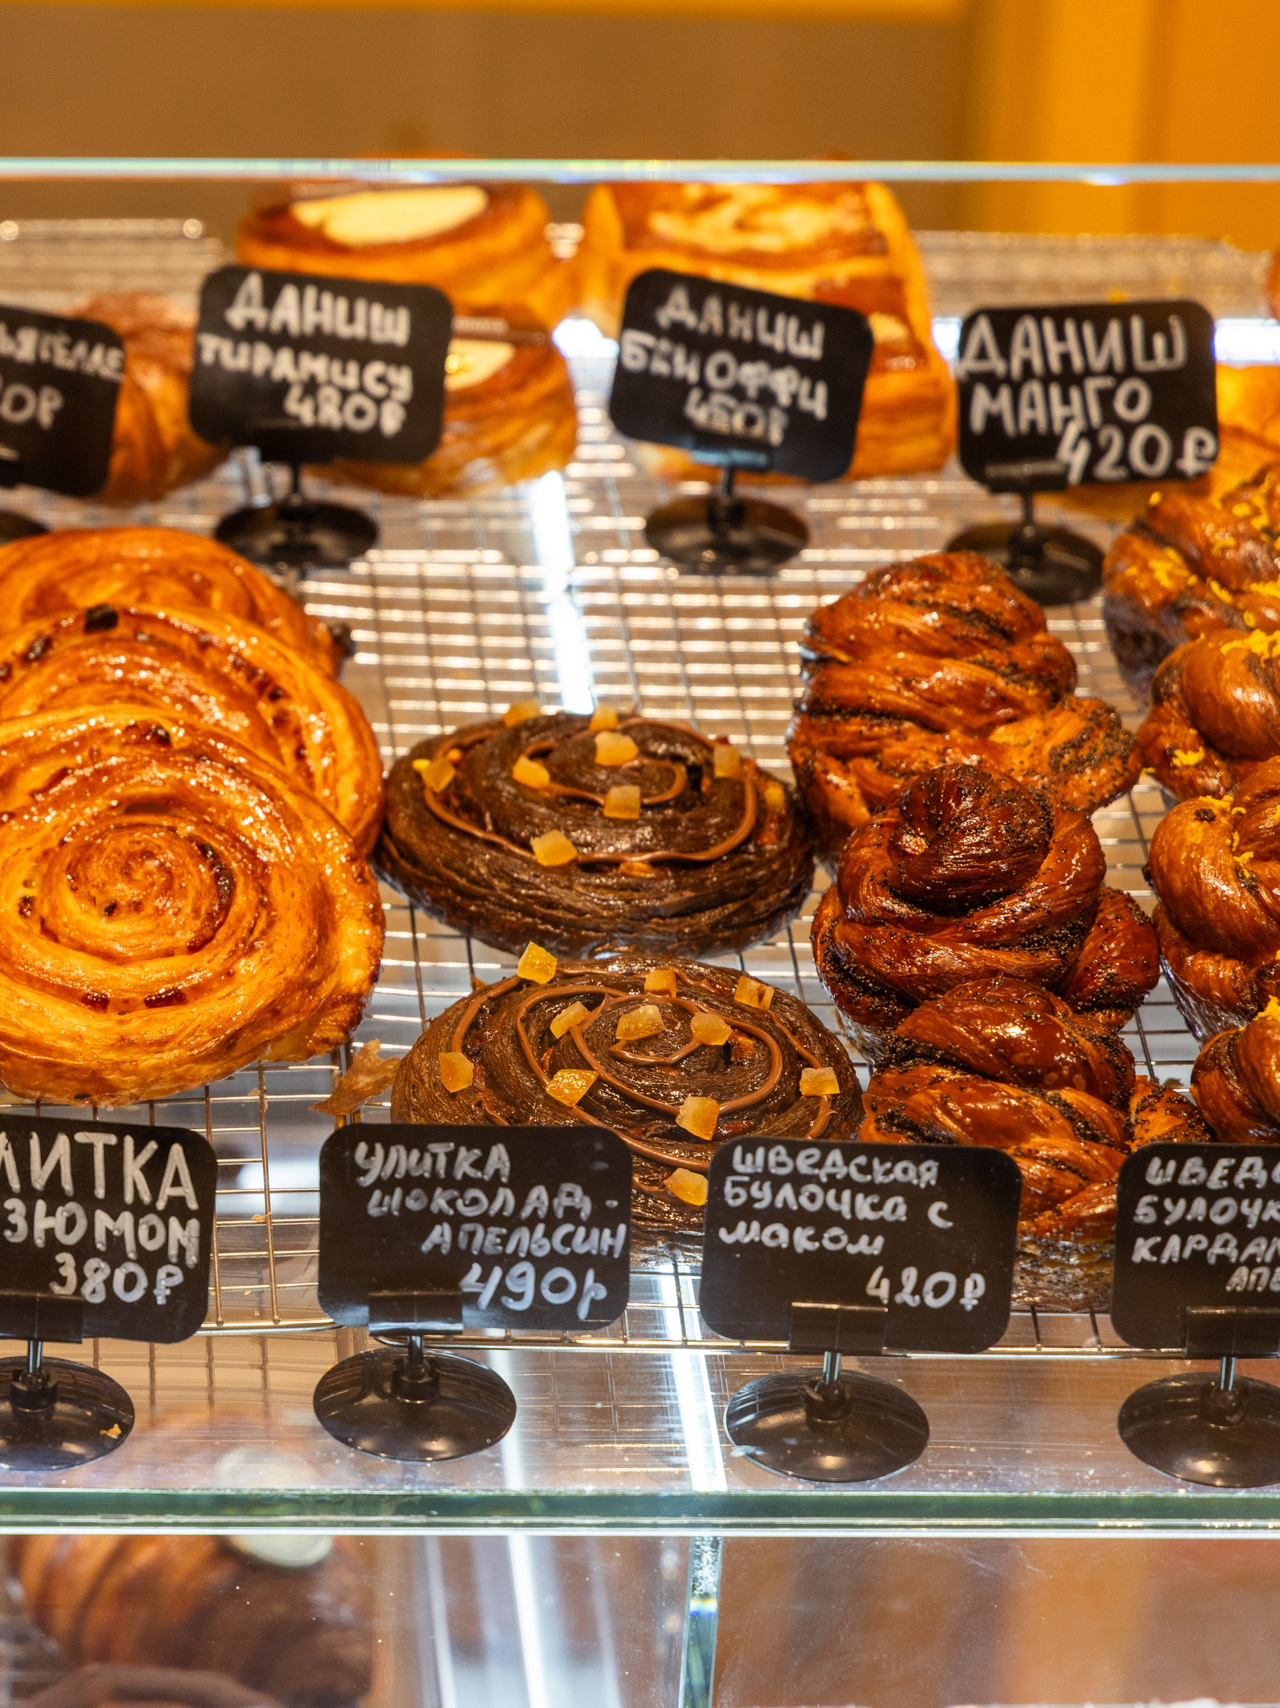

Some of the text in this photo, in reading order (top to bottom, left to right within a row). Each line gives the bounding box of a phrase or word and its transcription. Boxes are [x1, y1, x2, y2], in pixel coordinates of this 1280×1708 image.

[224, 271, 411, 347] ДАНИШ
[654, 283, 825, 361] ДАНИШ
[198, 332, 413, 404] ТИРАМИСУ
[958, 313, 1188, 382] ДАНИШ
[970, 375, 1152, 438] МАНГО
[354, 1141, 511, 1187] УЛИТКА
[421, 1221, 627, 1258] АПЕЛЬСИН
